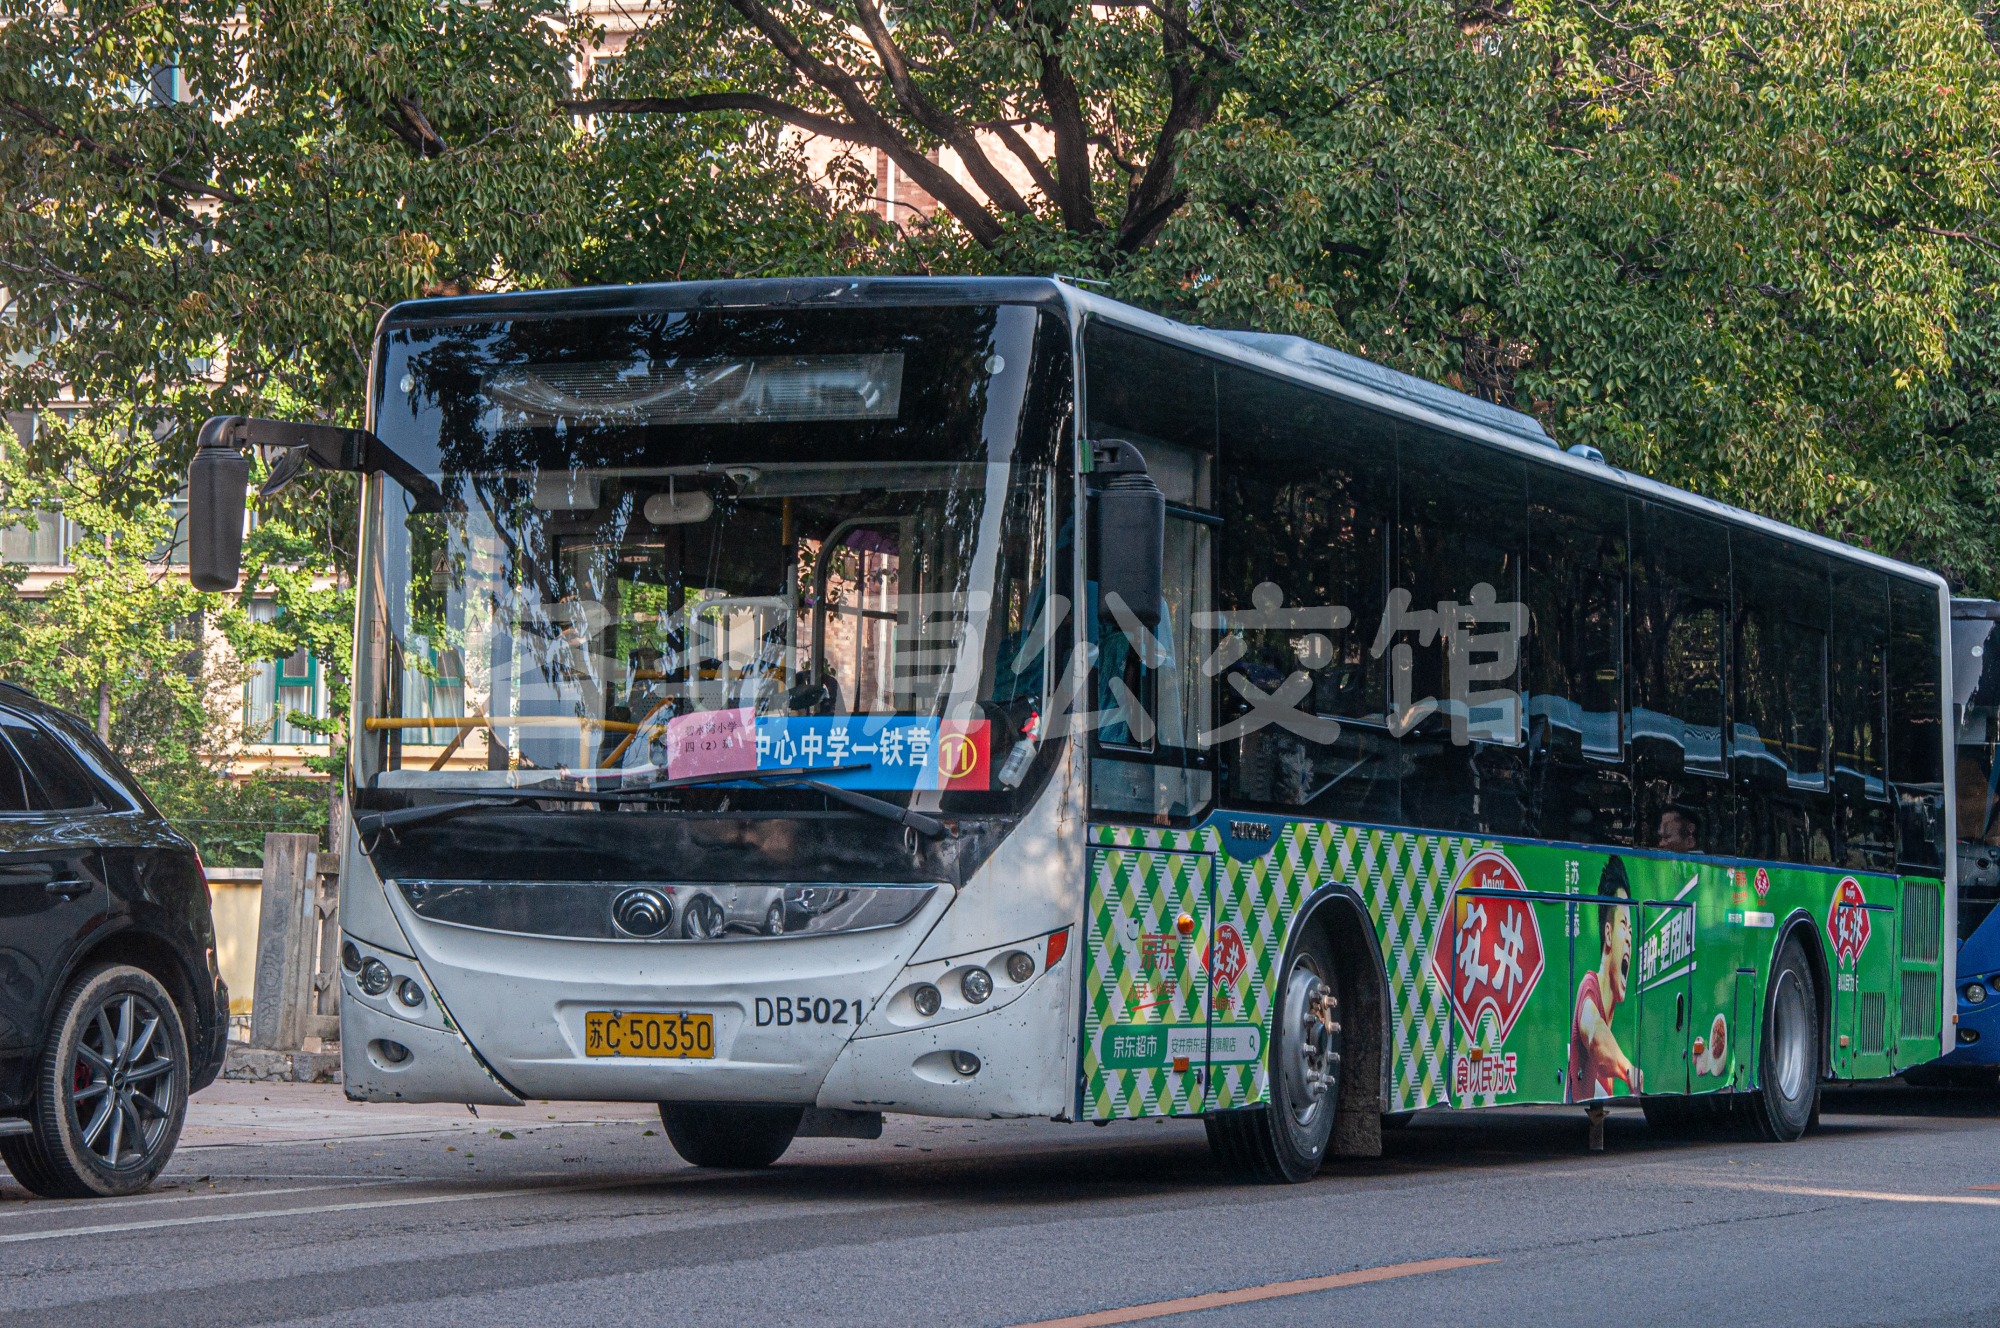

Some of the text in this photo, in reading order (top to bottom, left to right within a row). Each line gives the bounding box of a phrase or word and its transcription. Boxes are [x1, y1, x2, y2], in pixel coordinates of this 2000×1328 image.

[1140, 932, 1176, 970] 京东
[1455, 901, 1524, 1004] 安井
[755, 997, 863, 1027] DB5021
[1113, 1035, 1158, 1058] 京东超市
[1456, 1055, 1516, 1094] 食以民为天
